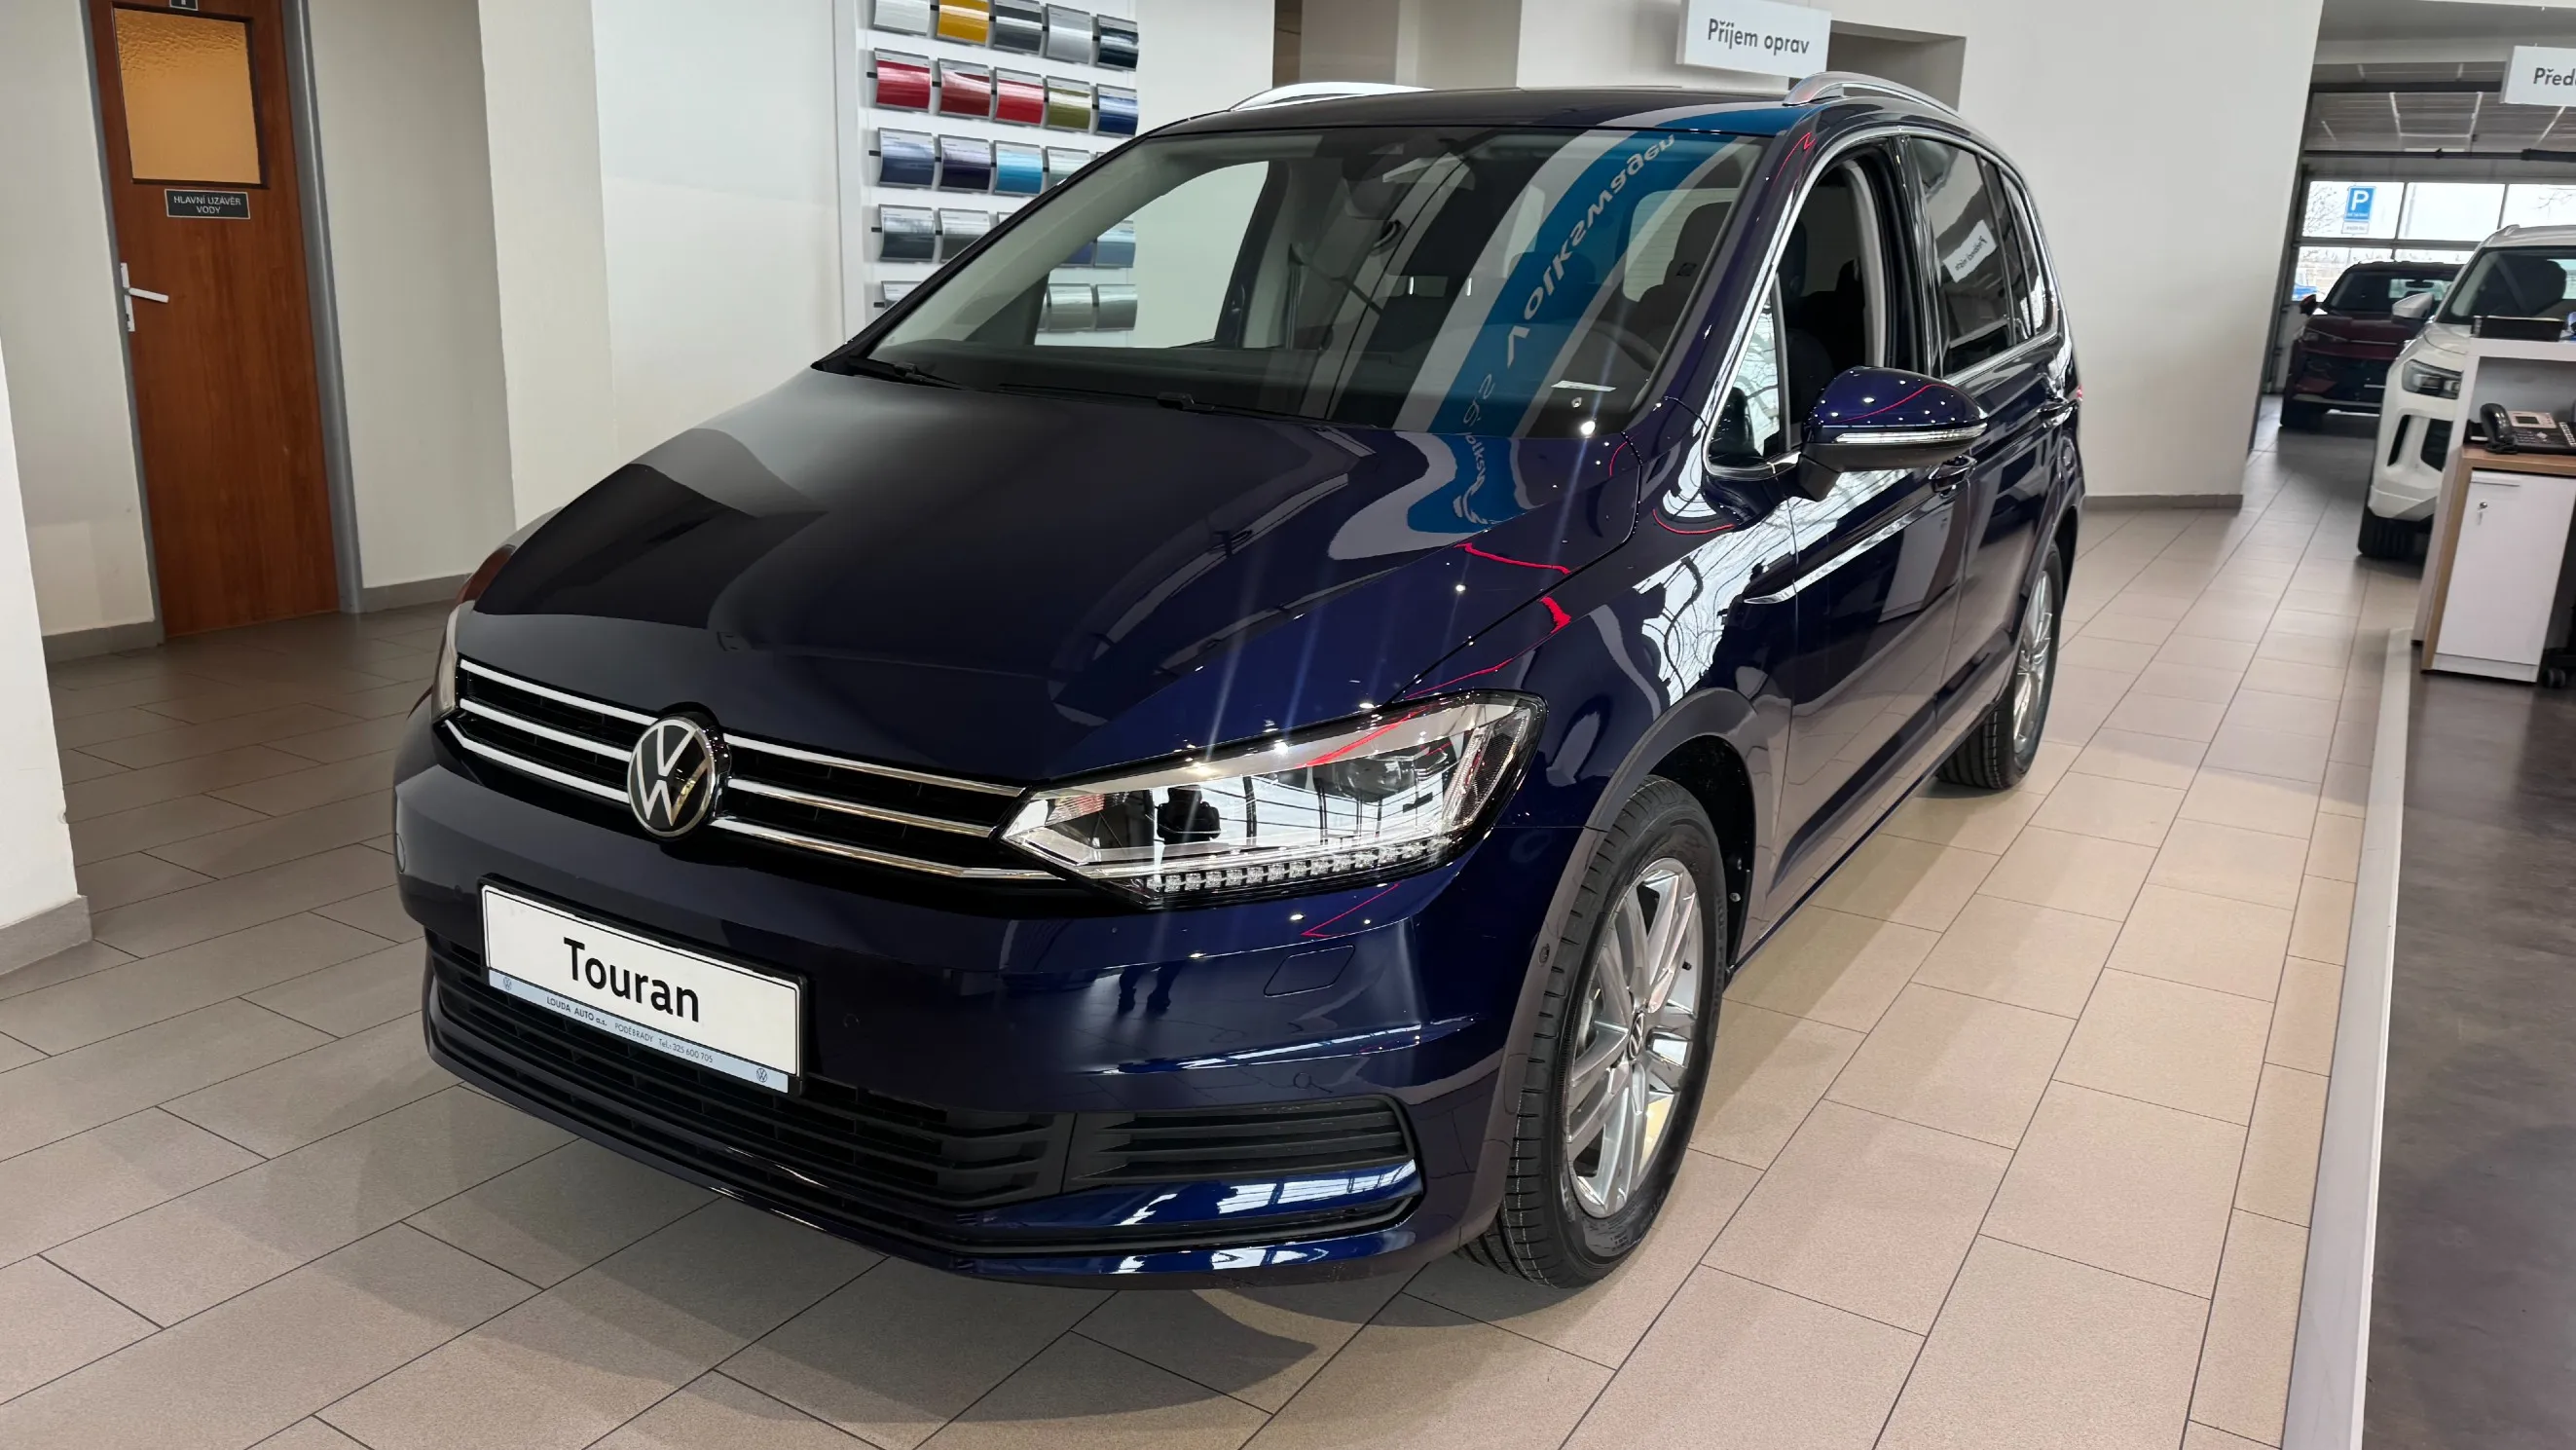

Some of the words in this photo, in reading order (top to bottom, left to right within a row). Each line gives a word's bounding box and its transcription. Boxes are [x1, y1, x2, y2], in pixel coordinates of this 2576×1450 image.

[1708, 18, 1758, 50] Příjem
[1764, 35, 1810, 56] oprav
[2532, 67, 2576, 86] Před
[173, 195, 205, 204] HLAVNÍ
[196, 205, 221, 214] VODY
[2351, 190, 2370, 211] P
[563, 937, 699, 1022] Touran
[546, 996, 571, 1013] LOUDA
[574, 1007, 594, 1021] AUTO
[673, 1043, 684, 1054] 325
[686, 1048, 699, 1059] 600
[701, 1052, 713, 1063] 705
